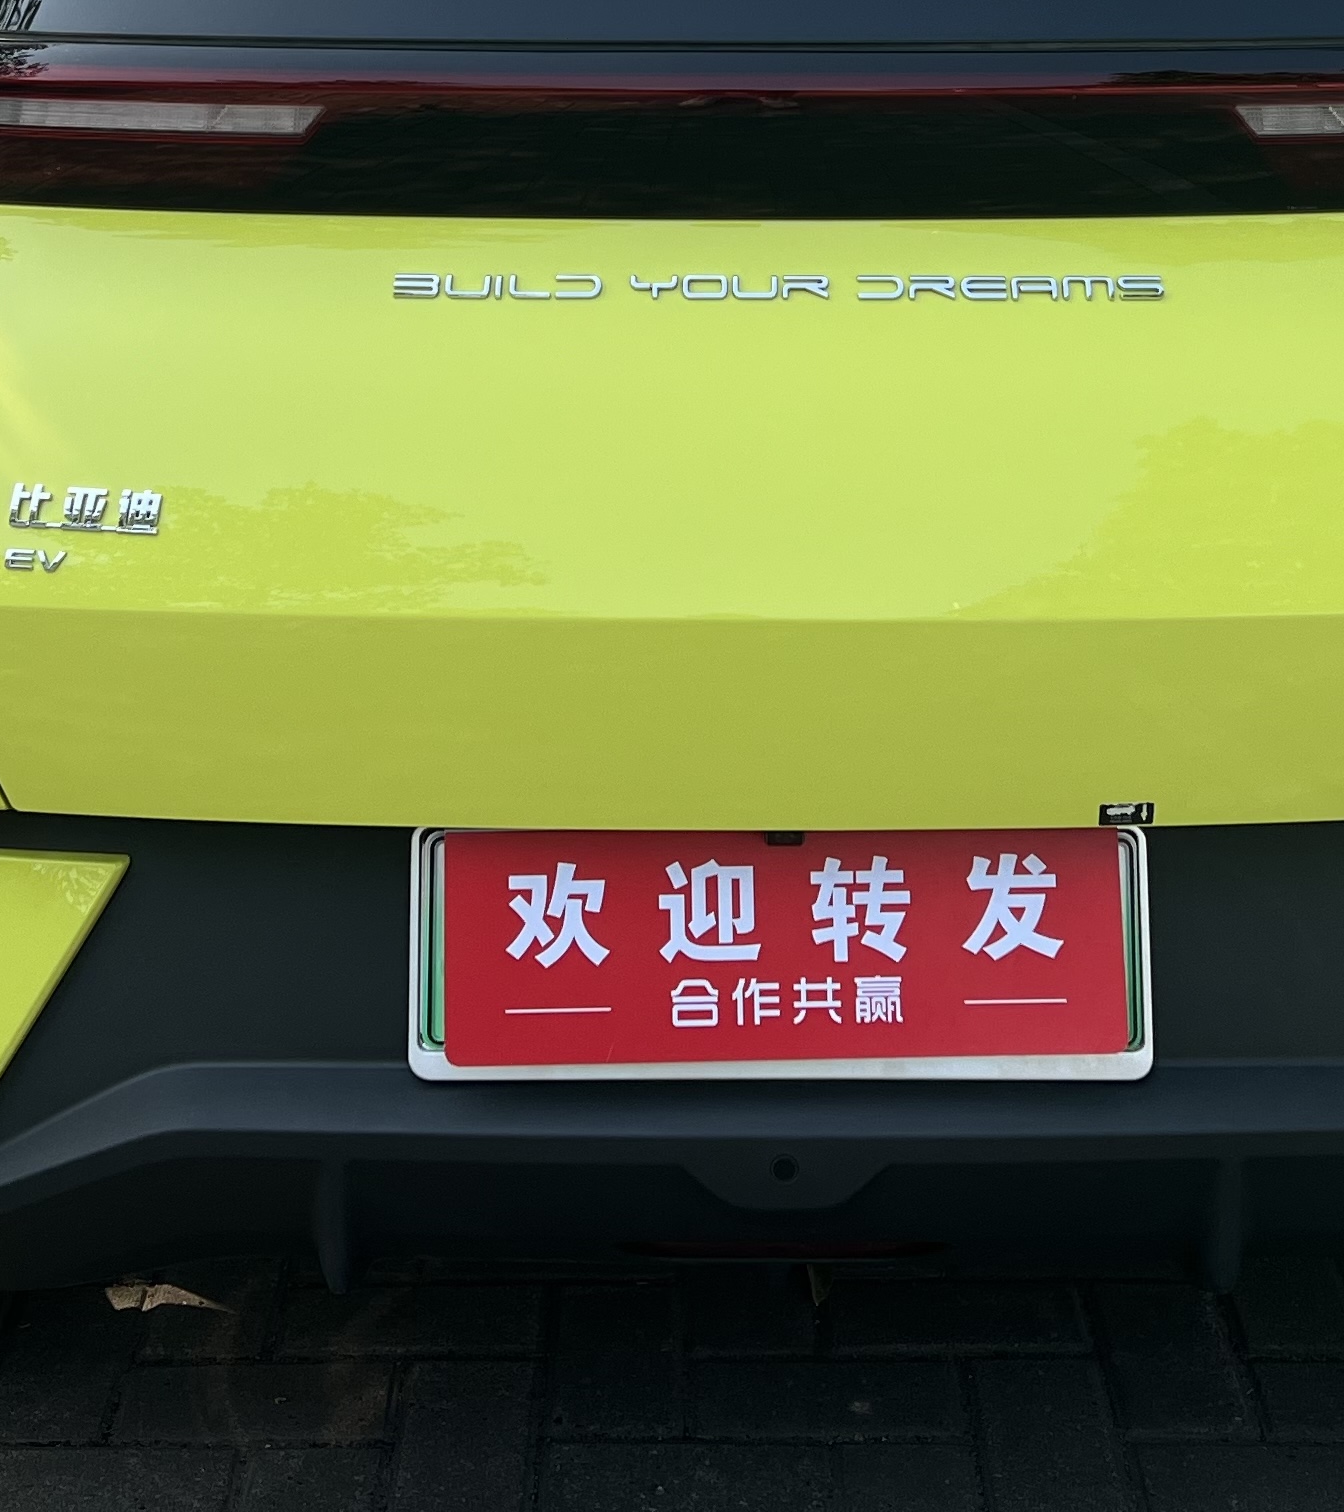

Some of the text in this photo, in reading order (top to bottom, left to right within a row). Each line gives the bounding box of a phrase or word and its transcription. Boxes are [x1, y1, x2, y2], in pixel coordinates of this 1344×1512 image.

[393, 274, 1164, 301] BUILD YOUR DREAMS
[9, 482, 163, 535] 比亚迪
[4, 548, 67, 572] EV
[505, 853, 1065, 968] 欢迎转发
[670, 975, 903, 1028] 合作共赢
